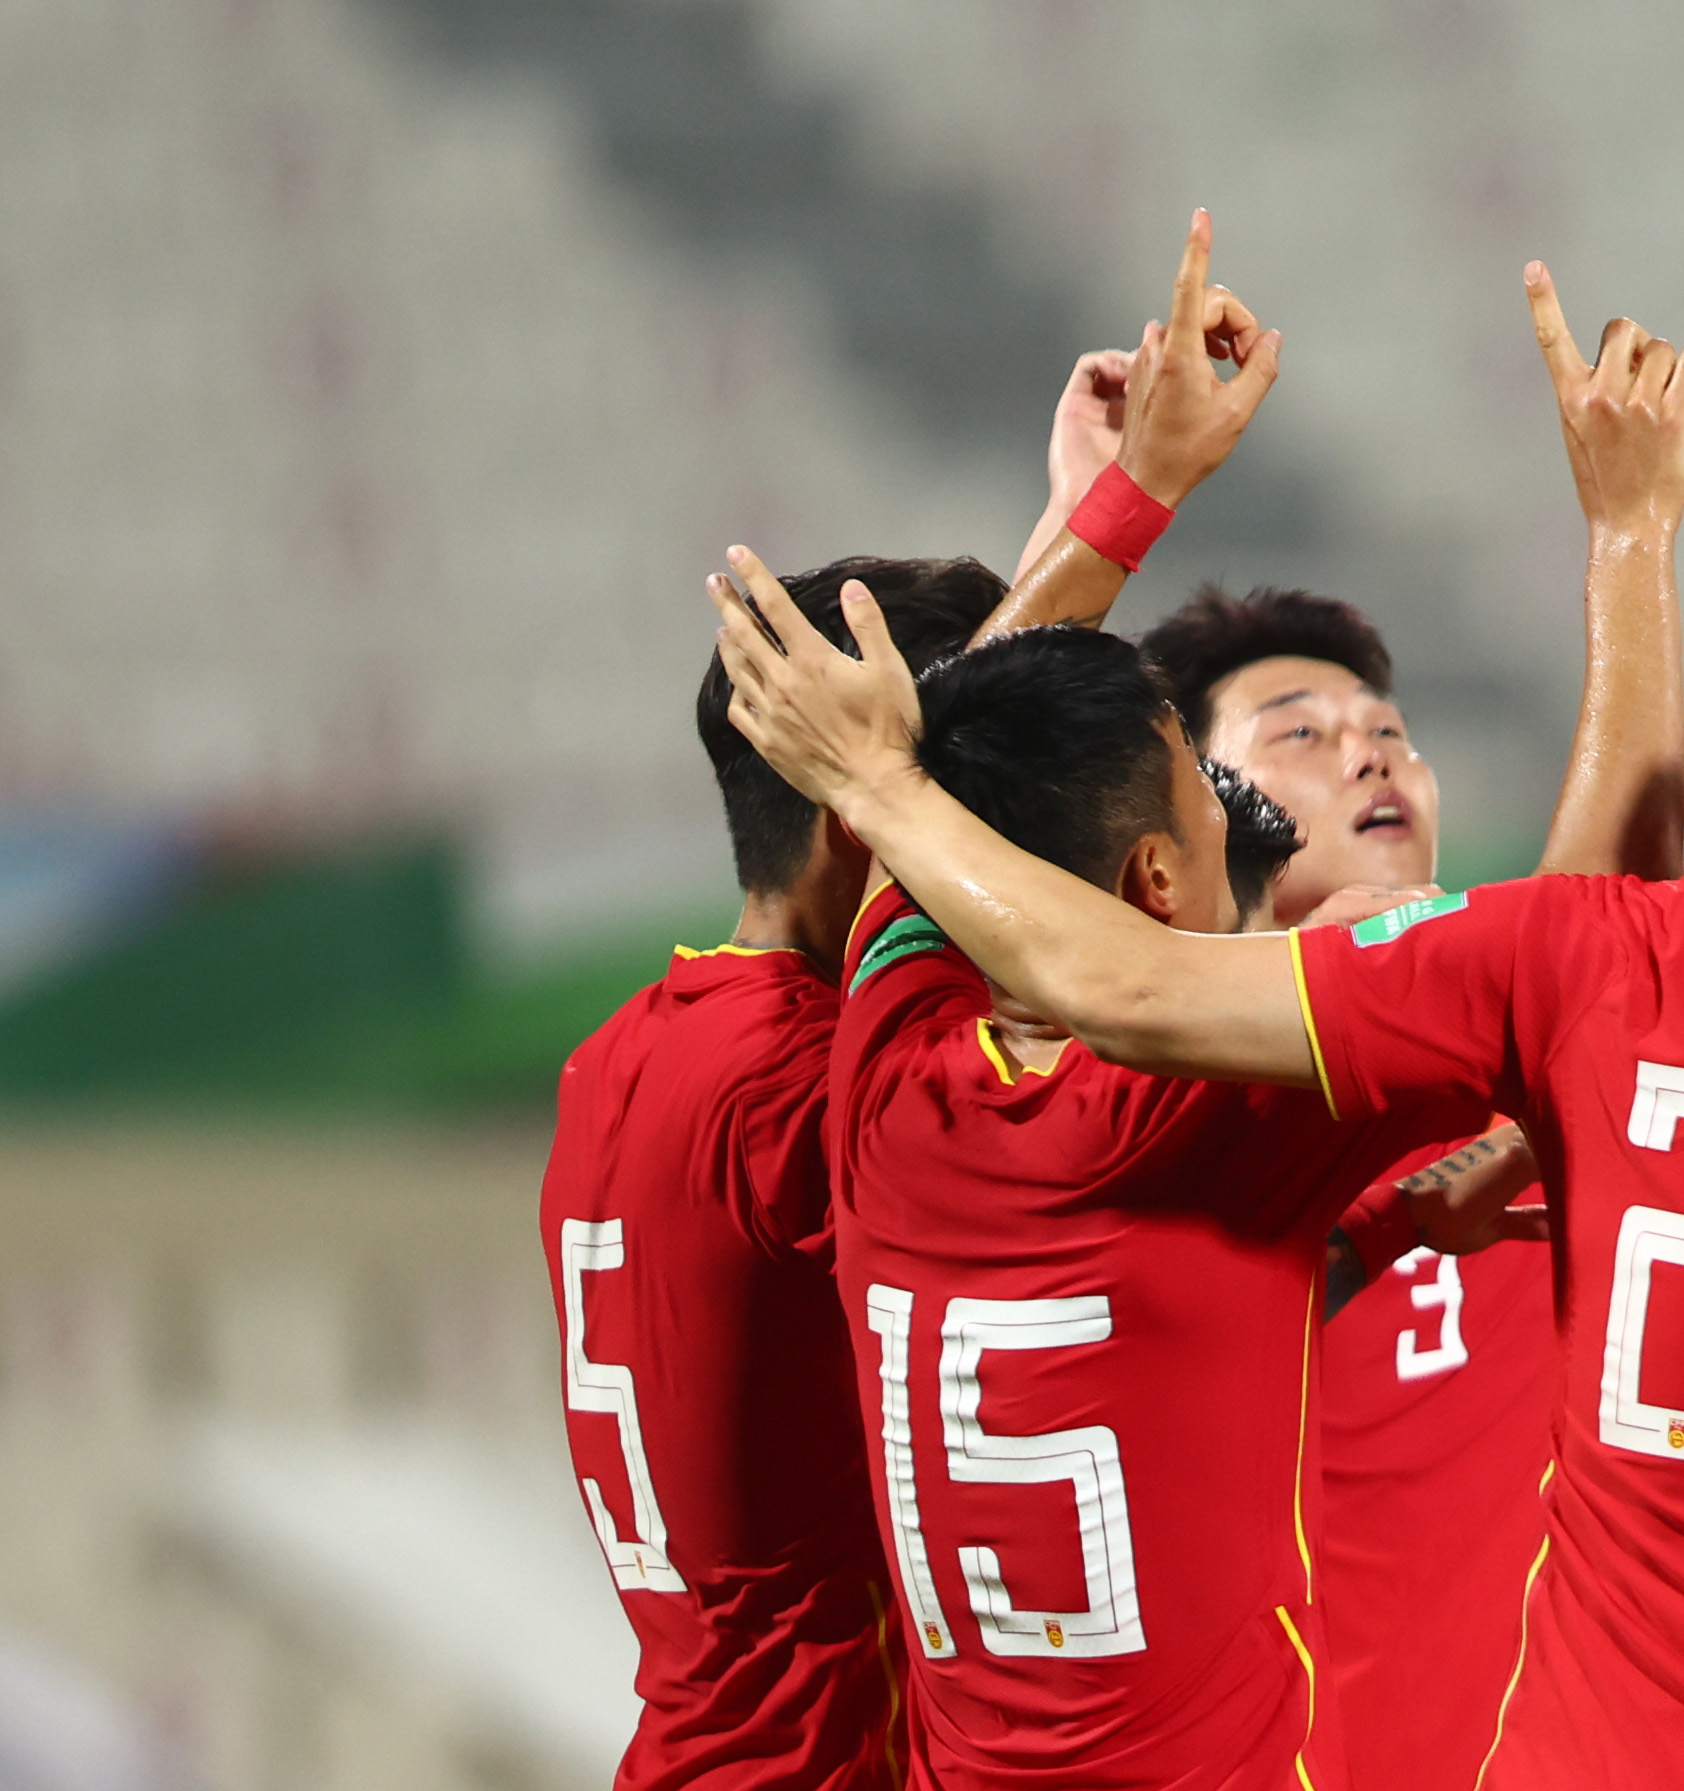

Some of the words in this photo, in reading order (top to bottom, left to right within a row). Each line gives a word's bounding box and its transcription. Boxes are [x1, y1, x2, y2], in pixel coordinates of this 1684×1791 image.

[561, 1217, 689, 1593] 5
[867, 1284, 1147, 1659] 15
[1393, 1245, 1469, 1382] 3
